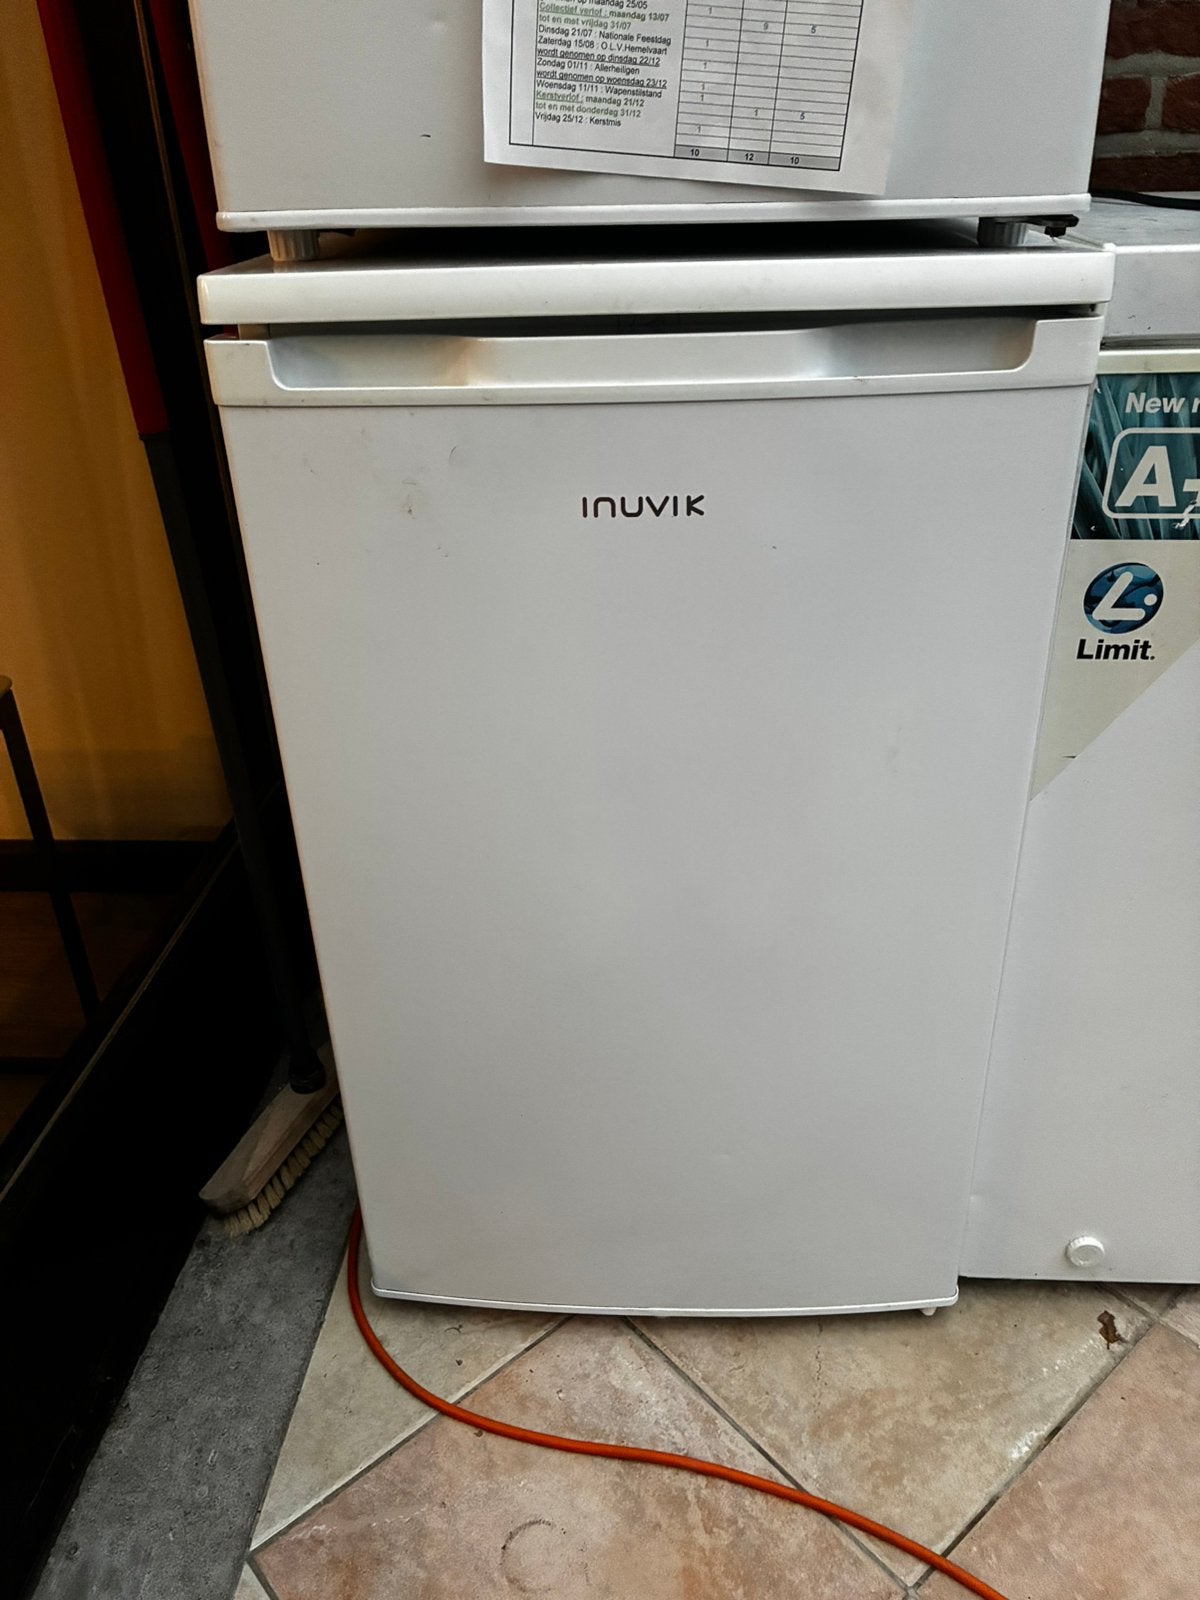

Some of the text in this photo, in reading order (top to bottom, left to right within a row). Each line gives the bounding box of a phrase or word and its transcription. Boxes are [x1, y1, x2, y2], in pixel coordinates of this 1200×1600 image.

[539, 2, 578, 14] Collectief
[609, 10, 646, 21] maandag
[649, 12, 670, 22] 13/07
[626, 0, 648, 9] 25/05
[539, 14, 550, 22] tot
[564, 17, 579, 25] met
[581, 18, 608, 29] vrijdag
[610, 20, 632, 30] 31/07
[538, 24, 570, 37] Dinsdag
[571, 27, 593, 37] 21/07
[599, 30, 635, 42] Nationale
[637, 33, 672, 46] Feestdag
[538, 35, 571, 48] Zaterdag
[574, 39, 595, 49] 15/08
[537, 48, 661, 66] wordt genomen op dinsdag 22/12
[537, 57, 565, 69] Zondag
[567, 60, 588, 69] 01/11
[595, 63, 640, 75] Allerheiligen
[537, 69, 668, 88] wordt genomen op woensdag 23/12
[536, 79, 577, 92] Woensdag
[578, 82, 599, 92] 11/11
[606, 86, 662, 98] Wapenstilstand
[536, 90, 580, 101] Kerstverlof
[586, 95, 622, 107] maandag
[623, 97, 645, 107] 21/12
[536, 100, 547, 110] tot
[560, 103, 575, 112] met
[576, 104, 618, 117] donderdag
[620, 108, 642, 118] 31/12
[535, 112, 561, 123] Vrijdag
[562, 114, 583, 124] 25/12
[589, 116, 622, 127] Kerstmis
[690, 148, 700, 157] 10
[744, 153, 754, 161] 12
[789, 157, 800, 165] 10
[1125, 391, 1186, 413] New
